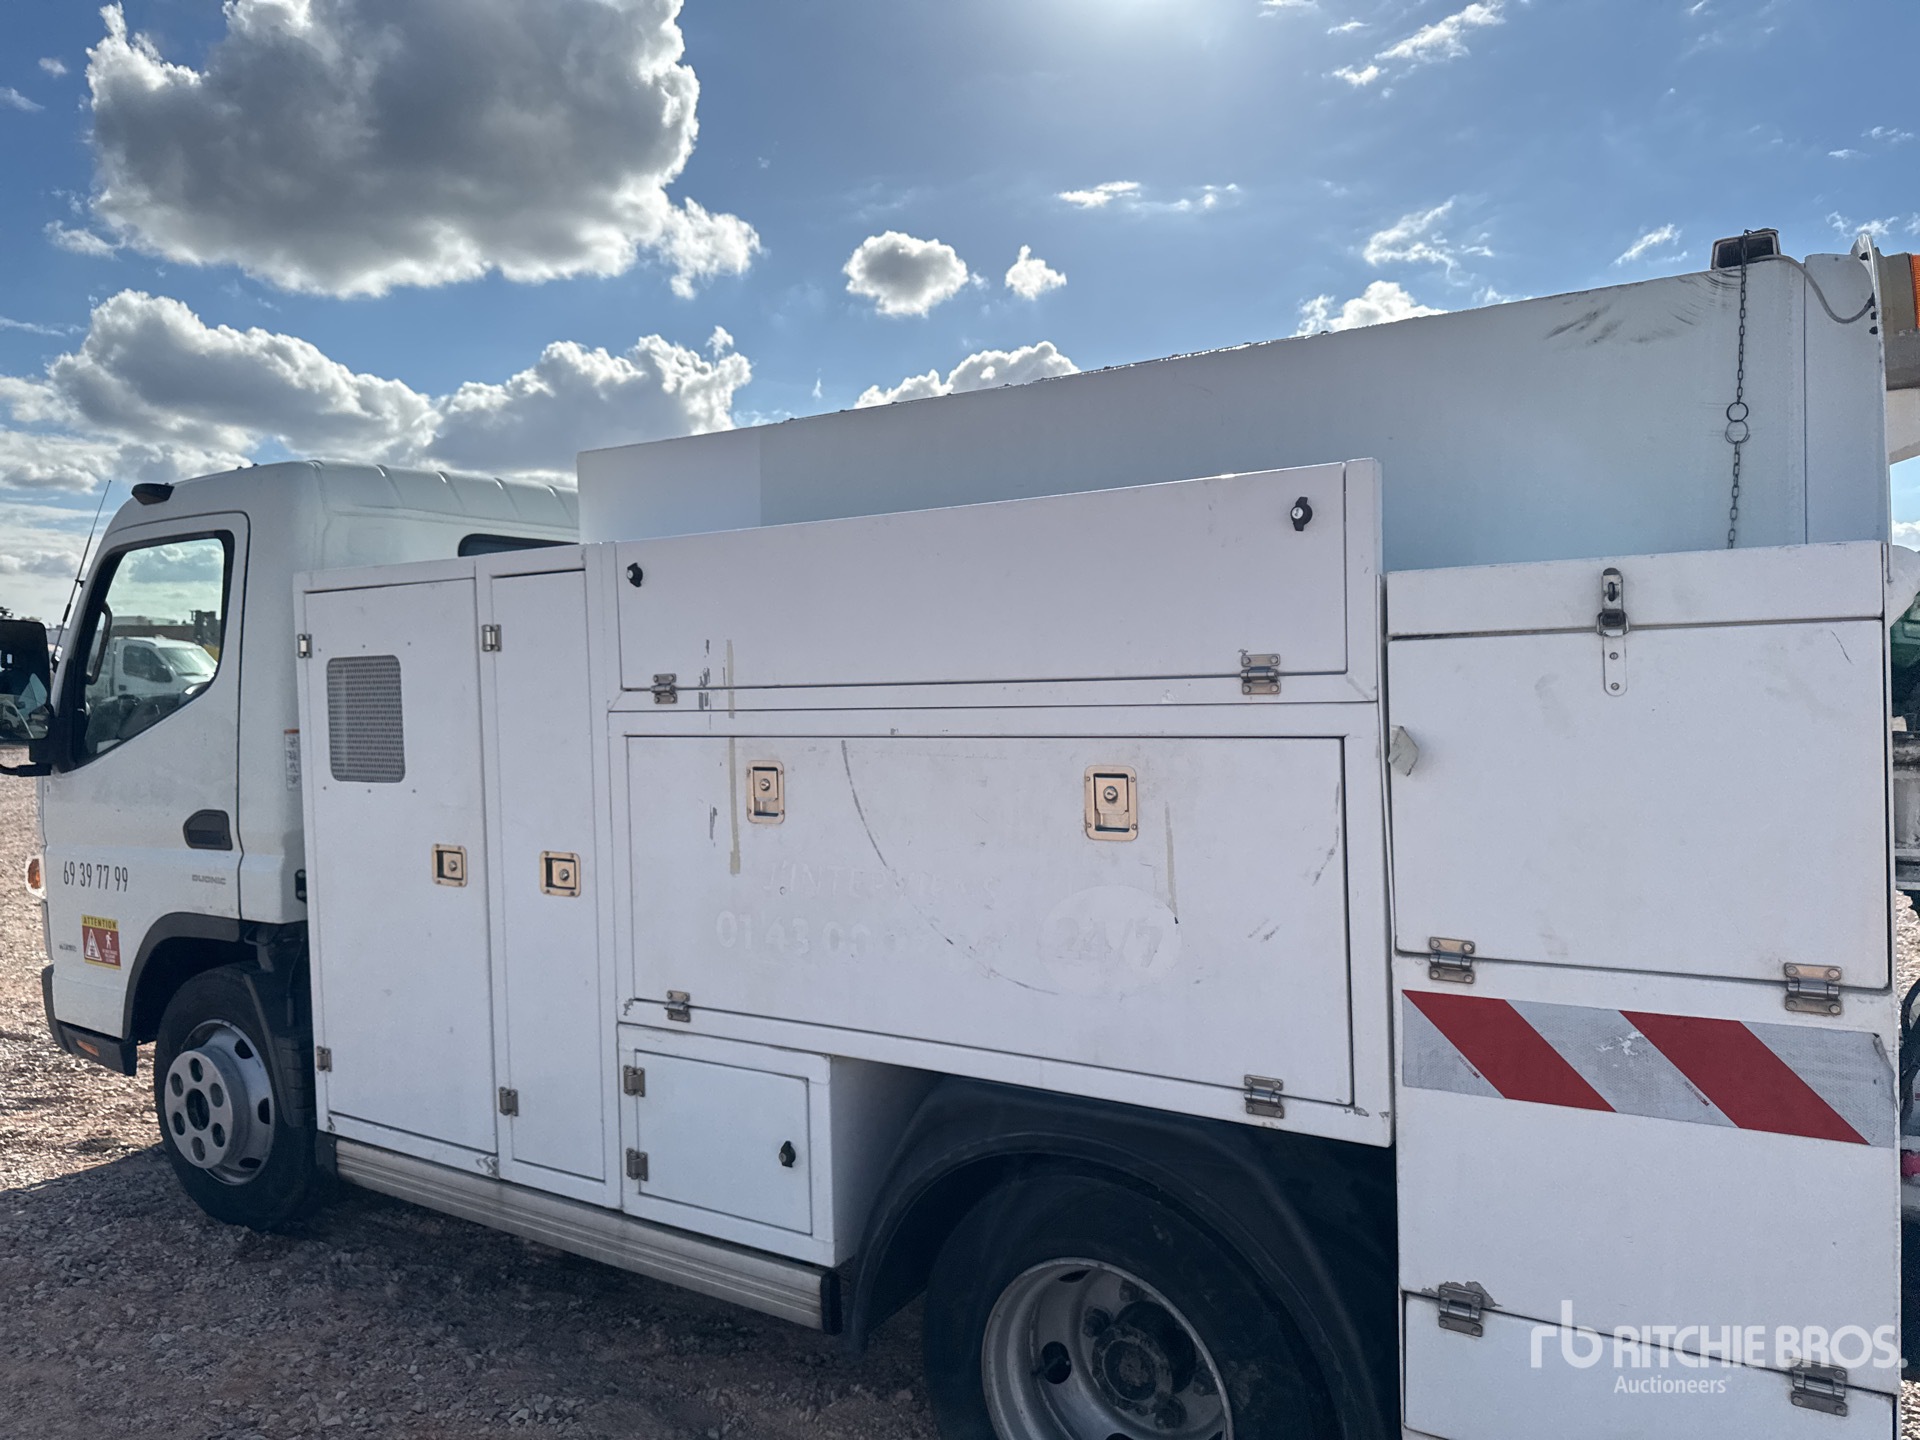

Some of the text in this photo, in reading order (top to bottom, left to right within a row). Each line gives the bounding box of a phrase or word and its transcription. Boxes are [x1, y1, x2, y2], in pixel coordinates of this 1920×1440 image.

[63, 860, 128, 892] 69 39 77 99
[82, 916, 117, 929] ATTENTION
